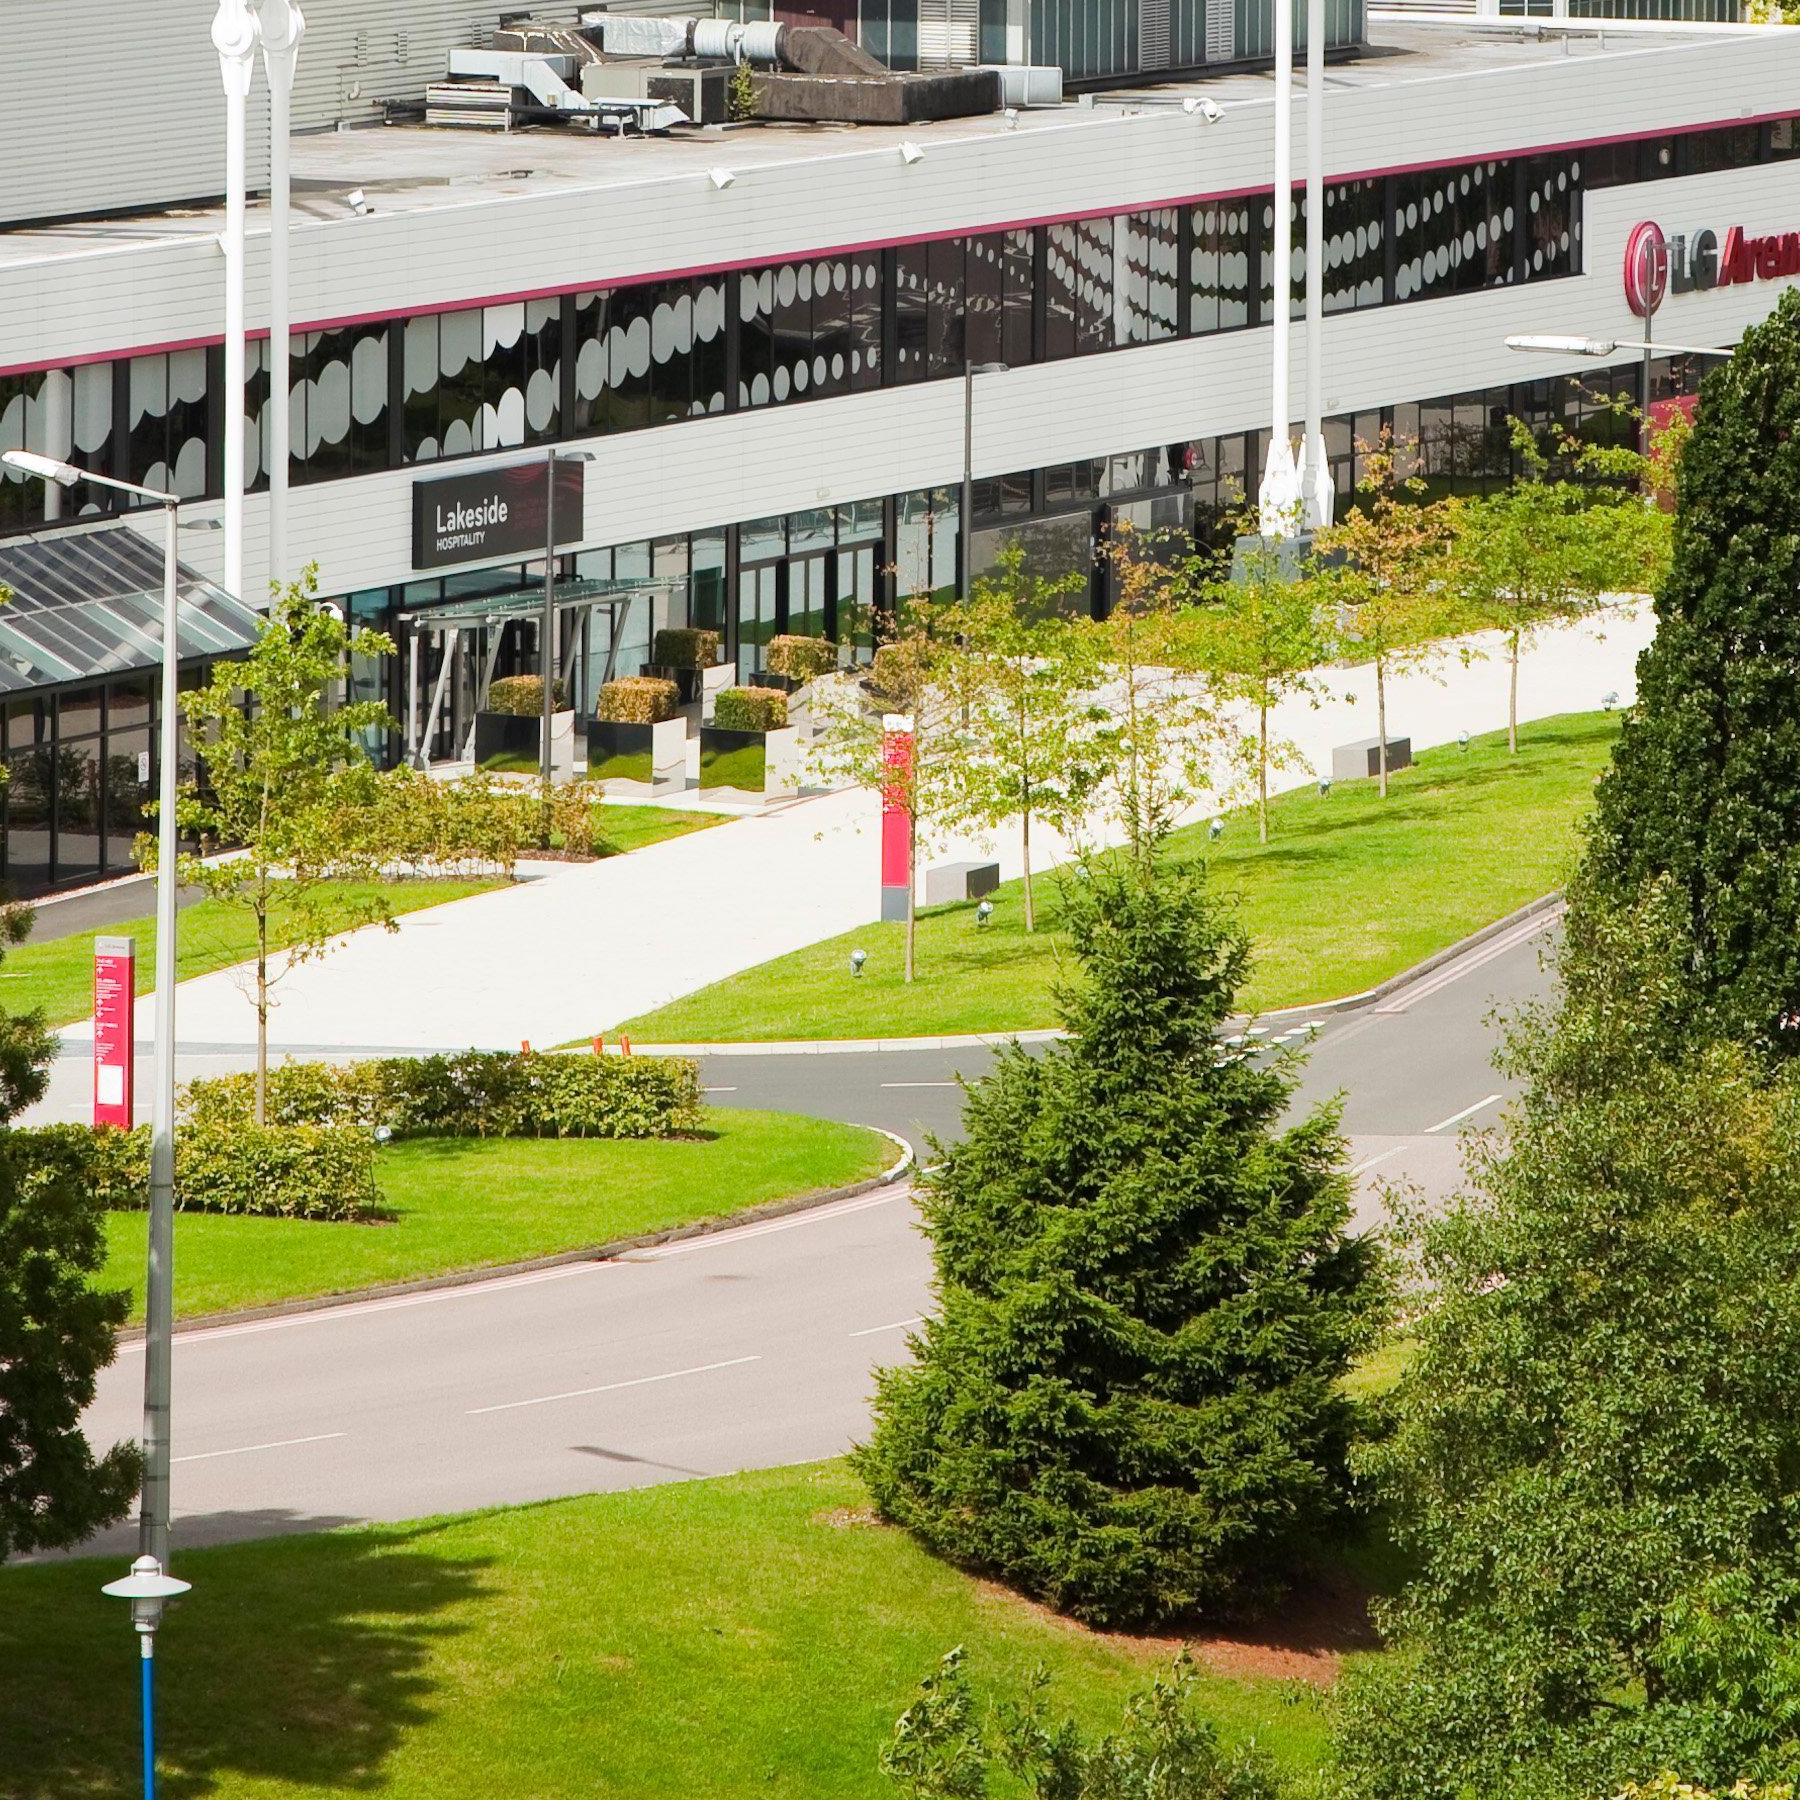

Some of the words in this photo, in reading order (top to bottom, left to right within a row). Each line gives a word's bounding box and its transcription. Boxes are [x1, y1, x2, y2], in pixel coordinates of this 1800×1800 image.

[1671, 228, 1718, 295] LG
[436, 494, 509, 534] Lakeside
[436, 530, 486, 552] HOSPITALITY
